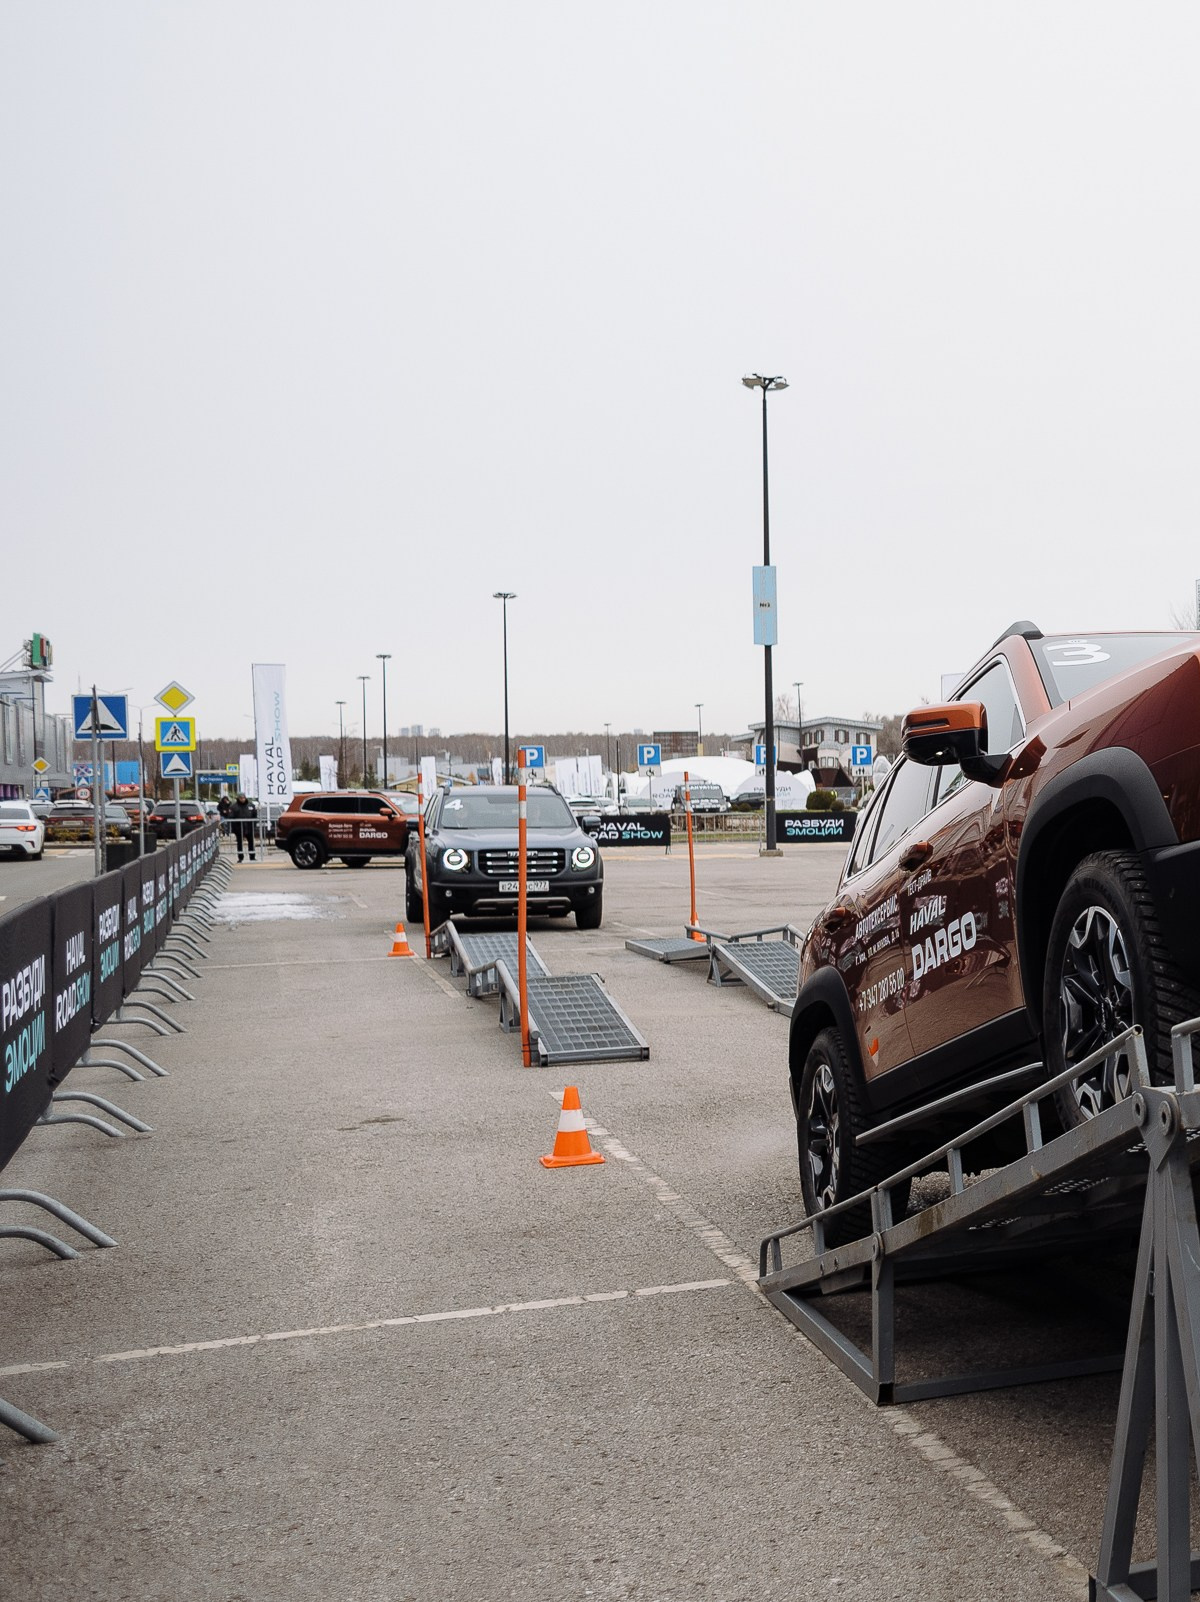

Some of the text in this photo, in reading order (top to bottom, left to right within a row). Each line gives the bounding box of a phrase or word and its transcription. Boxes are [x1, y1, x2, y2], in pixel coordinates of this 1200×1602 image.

[1047, 643, 1111, 666] 3
[274, 691, 287, 795] ROAD SHOW
[643, 747, 655, 764] P
[857, 748, 867, 764] P
[265, 737, 274, 795] HAVAL
[444, 799, 464, 810] 4
[785, 819, 844, 828] РАЗБУДИ
[588, 831, 663, 839] OAD SHOW
[786, 827, 842, 836] ЭМОЦИИ
[910, 896, 946, 935] HAVAL
[66, 931, 85, 975] HAVAL
[911, 911, 977, 981] DARGO
[2, 954, 46, 1032] РАЗБУДИ
[56, 970, 91, 1032] ROAD SHOW
[5, 1010, 46, 1093] ЭМОЦИИ
